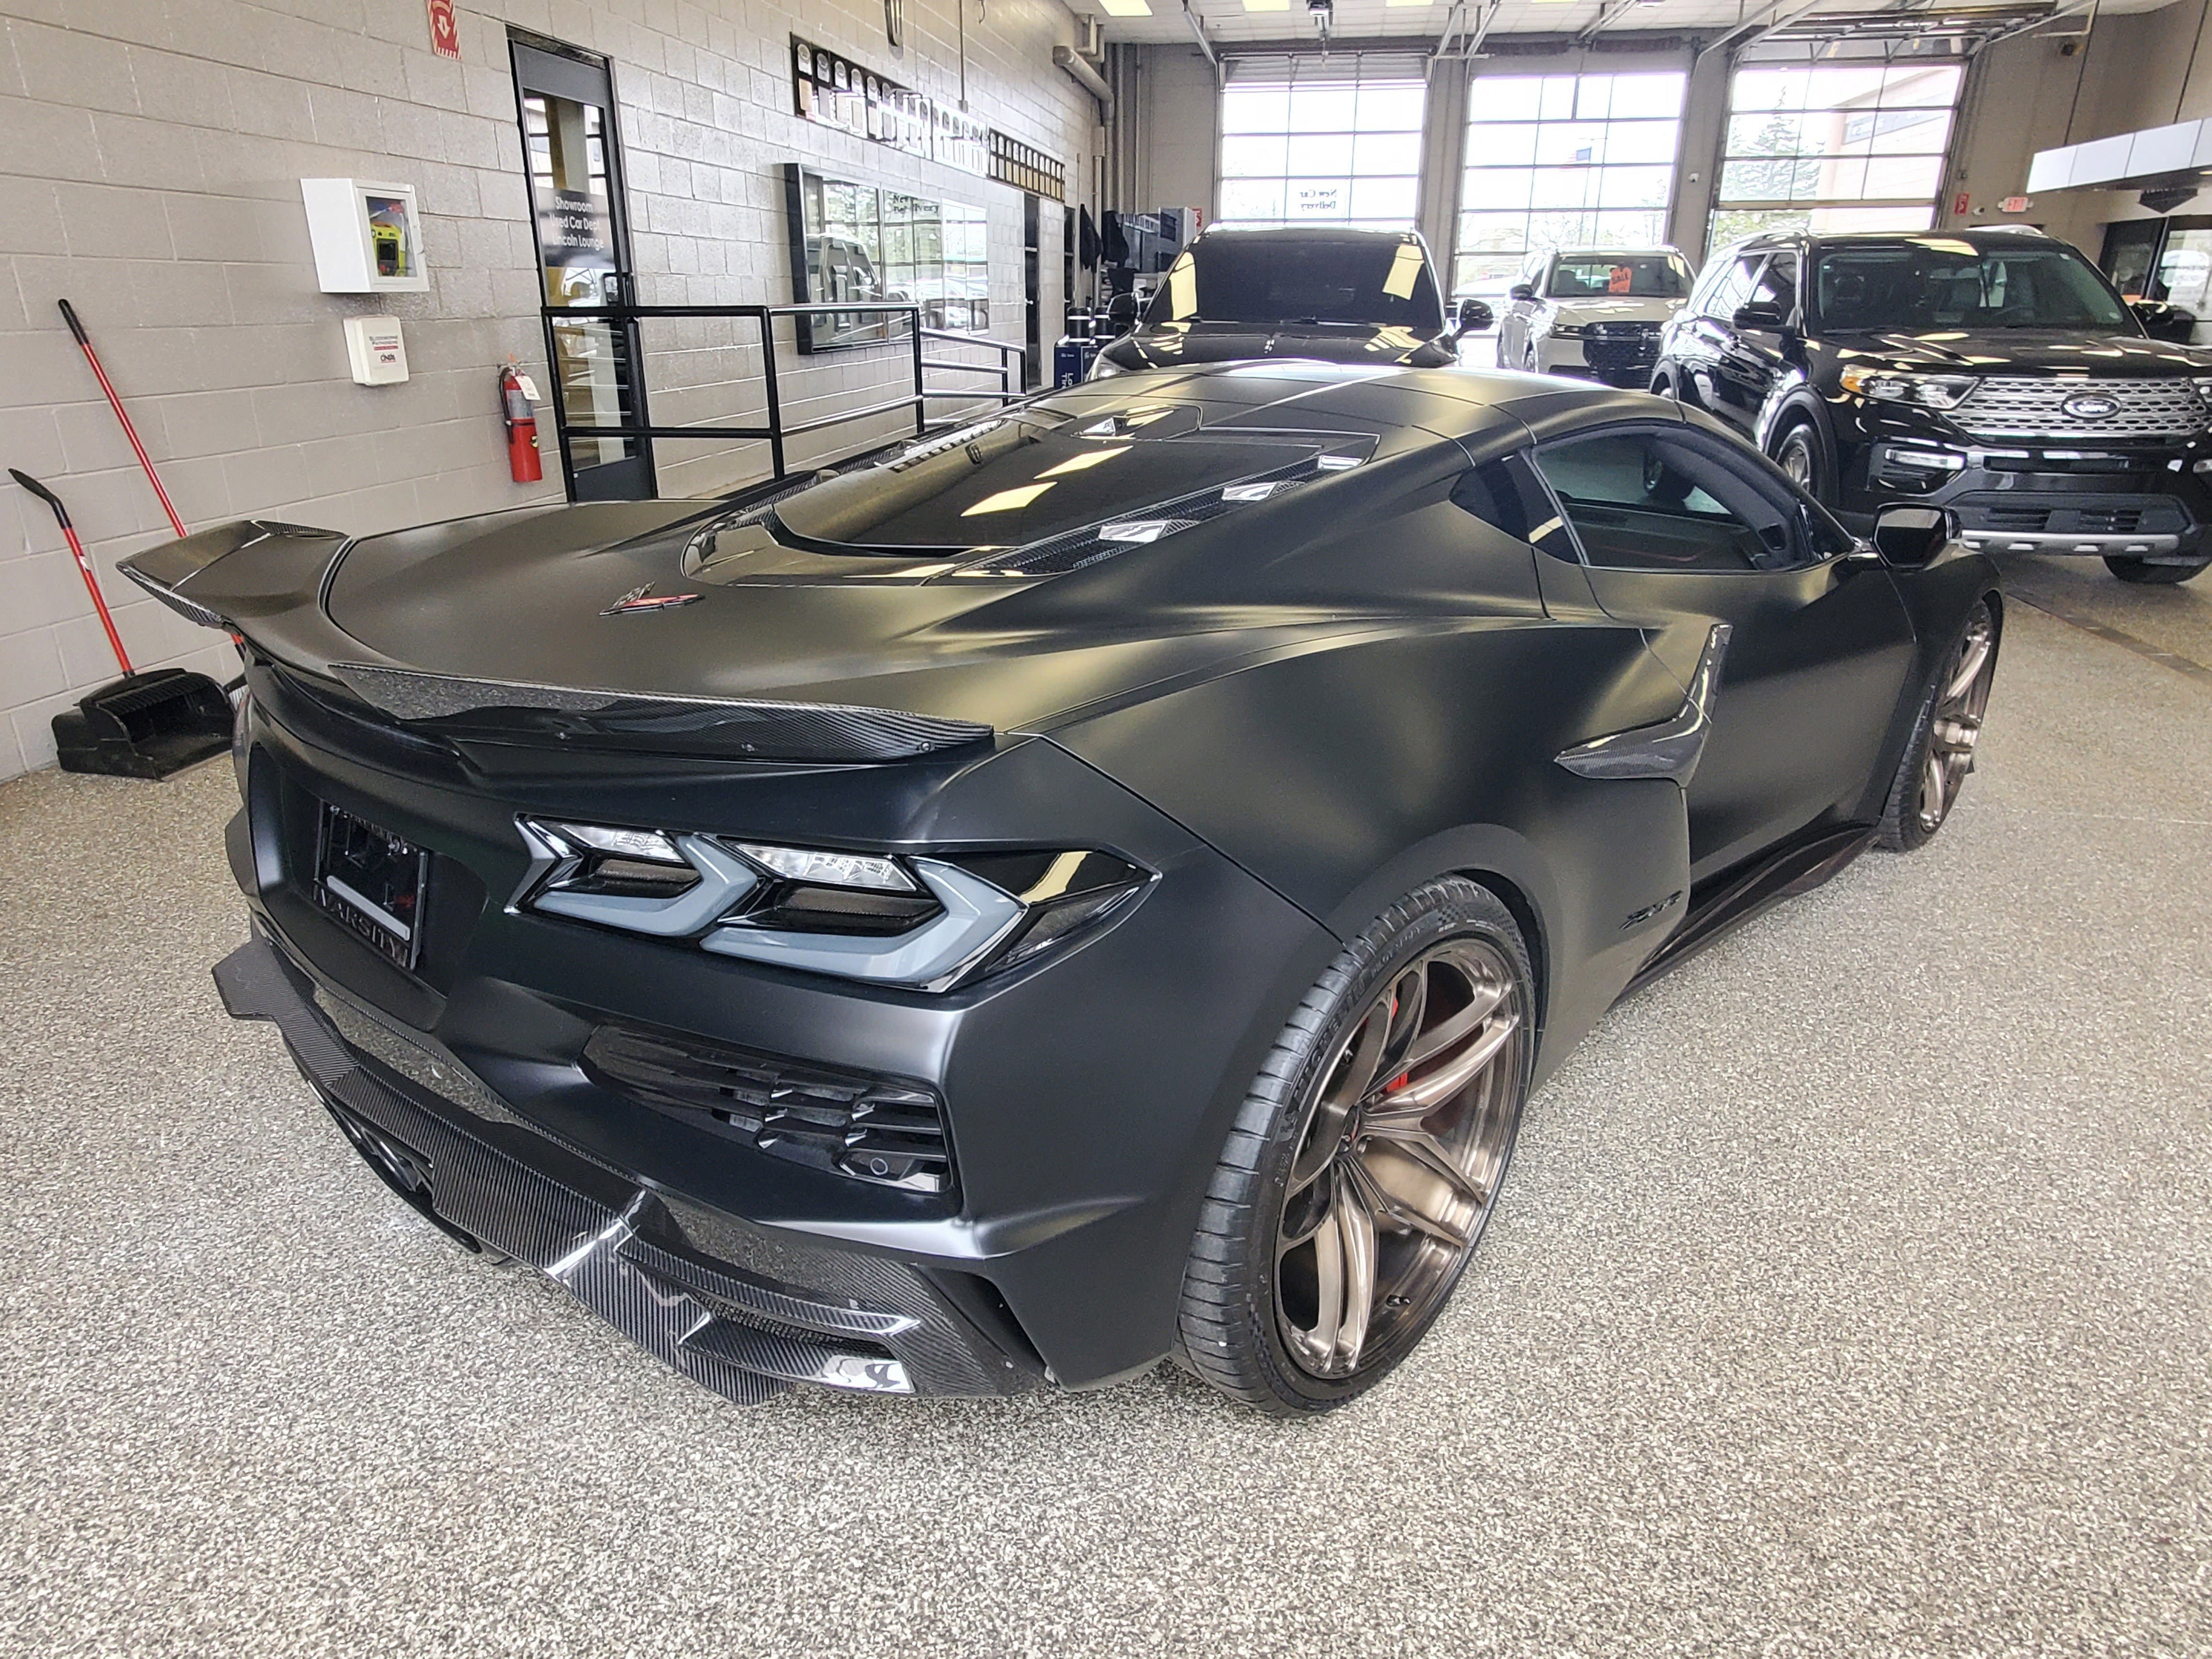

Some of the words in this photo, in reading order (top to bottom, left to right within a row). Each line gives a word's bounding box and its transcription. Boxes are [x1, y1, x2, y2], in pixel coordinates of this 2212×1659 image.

[555, 196, 593, 213] Showroom
[569, 216, 583, 229] Car
[553, 233, 578, 246] Lincoln
[578, 235, 604, 251] Lounge
